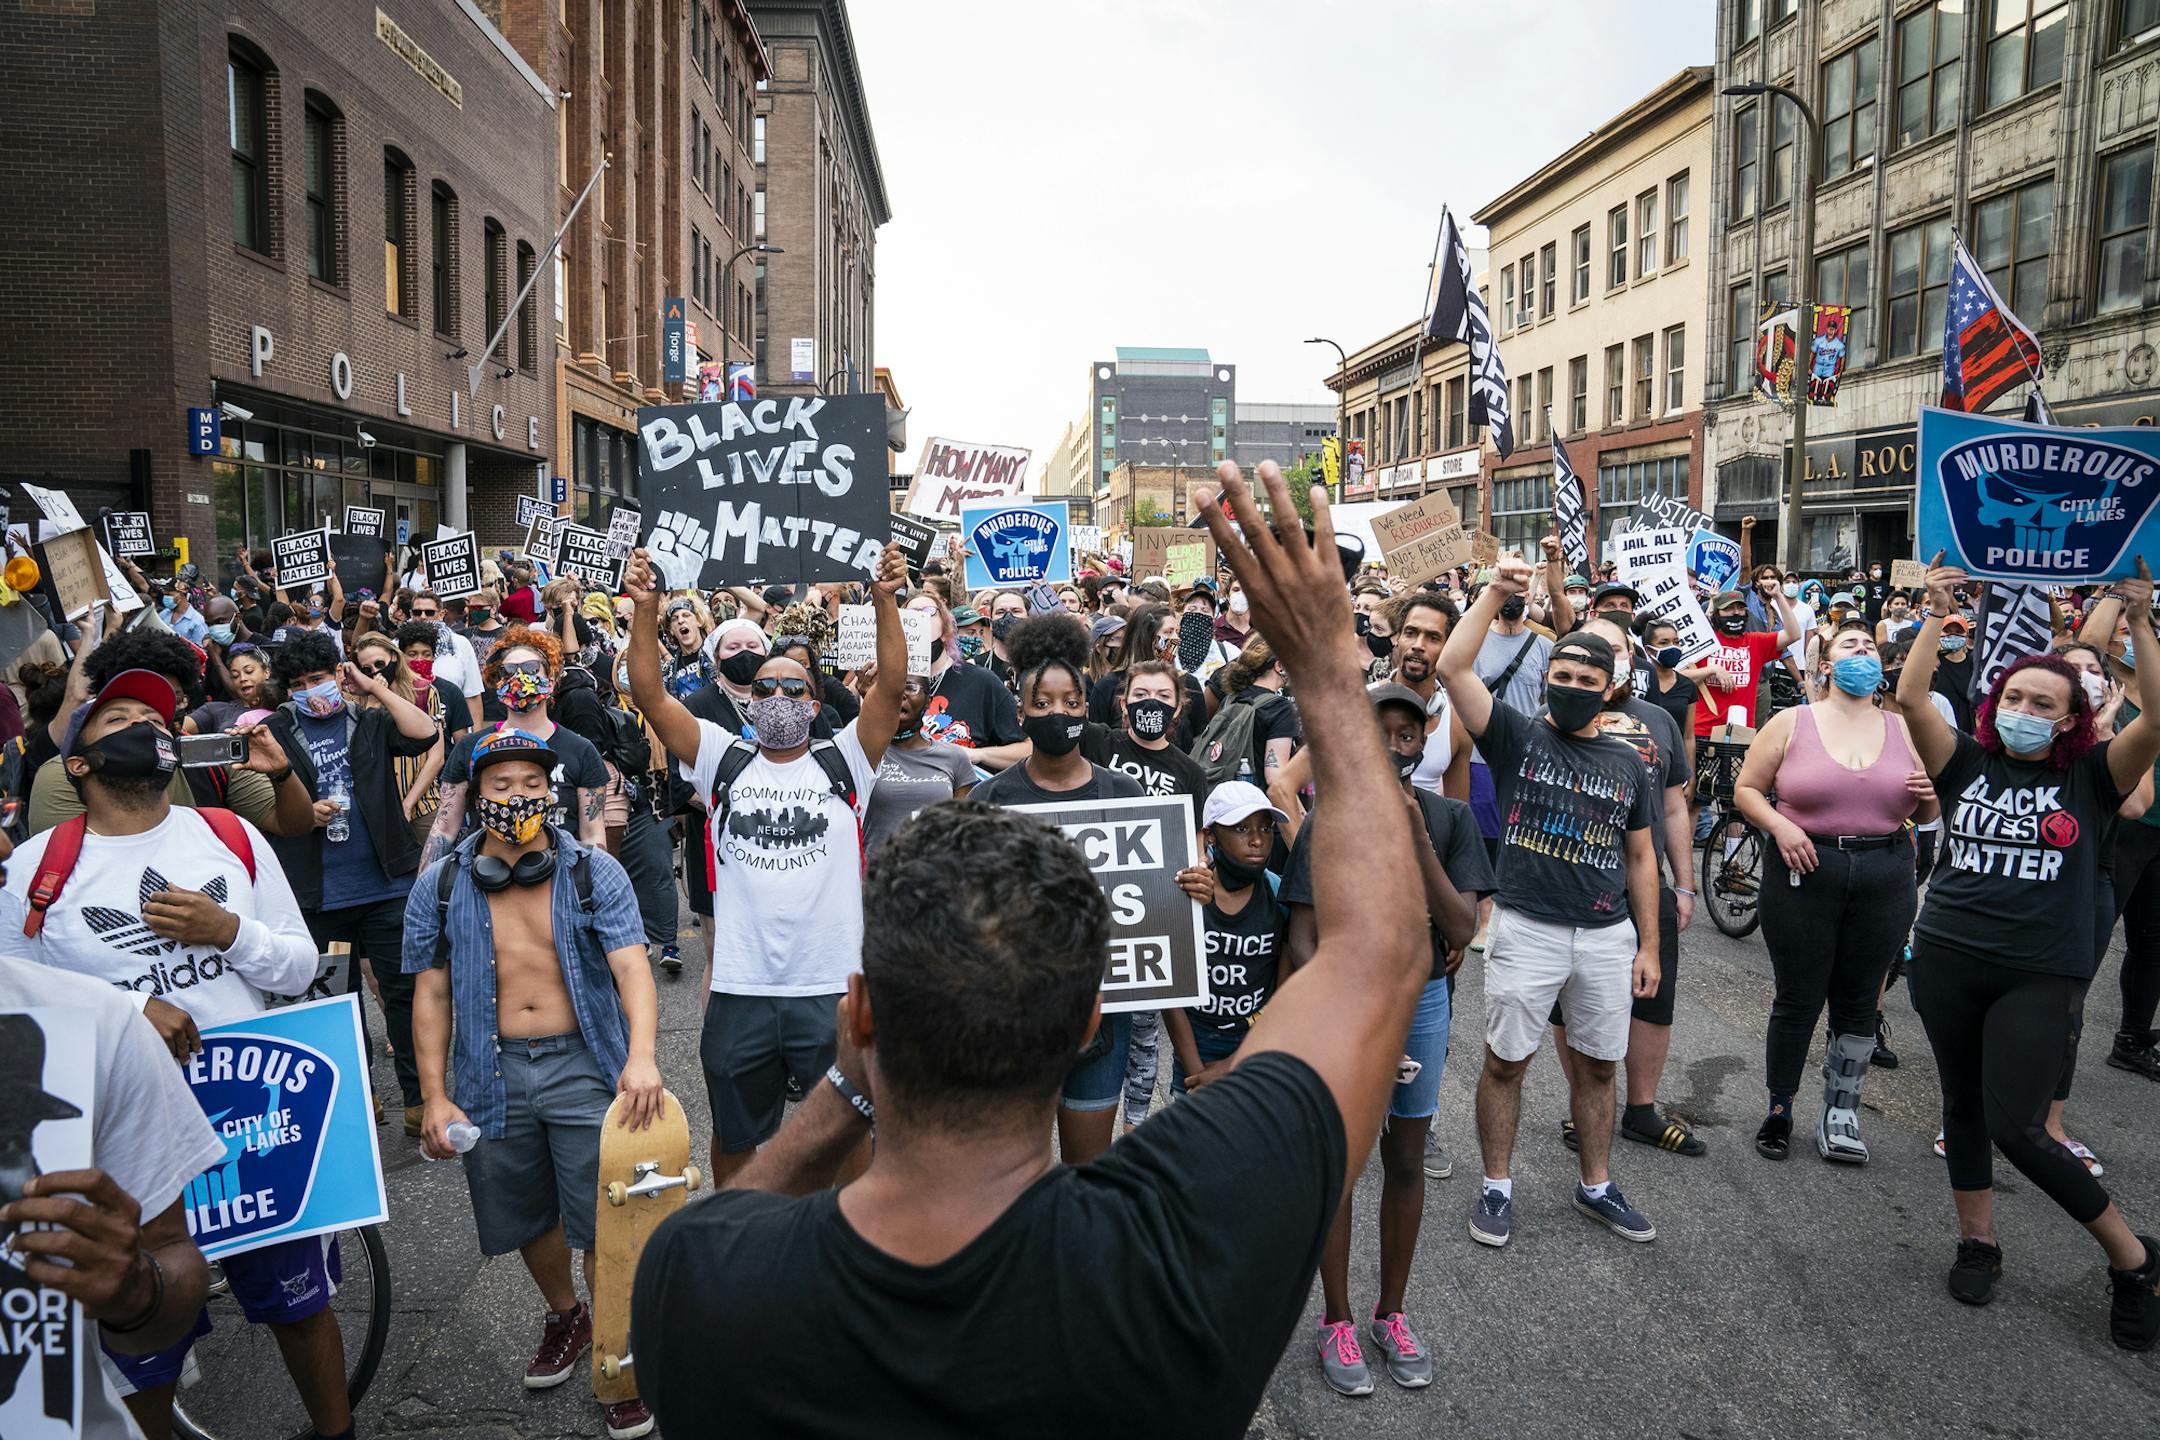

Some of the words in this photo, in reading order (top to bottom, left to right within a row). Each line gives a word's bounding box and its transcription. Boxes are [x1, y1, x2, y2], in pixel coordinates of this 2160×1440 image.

[669, 331, 681, 362] fjorge
[251, 325, 539, 450] POLICE
[200, 413, 213, 451] MPD
[641, 397, 826, 472] BLACK
[697, 440, 855, 497] LIVES
[925, 444, 979, 481] HOW
[972, 449, 1029, 486] MANY
[1443, 457, 1463, 475] STORE
[1803, 453, 1848, 481] L.A.
[1860, 443, 1915, 478] ROC
[1955, 444, 2154, 488] MURDEROUS
[1388, 467, 1414, 484] AMERICAN
[556, 480, 564, 501] MPD
[523, 498, 553, 513] BLACK
[1641, 491, 1713, 532] JUSTICE
[2060, 498, 2096, 513] CITY
[2100, 496, 2121, 511] OF
[2076, 507, 2126, 523] LAKES
[351, 511, 379, 525] BLACK
[978, 513, 1054, 539] MURDEROUS
[1378, 517, 1396, 532] We
[1398, 506, 1426, 523] Need
[1390, 510, 1452, 544] RESOURCES
[119, 529, 144, 540] IVES
[352, 523, 376, 537] LIVES
[890, 519, 908, 534] LACK
[909, 527, 929, 542] LIVES
[1070, 526, 1099, 537] LACK
[119, 539, 149, 551] ATTER
[279, 535, 322, 556] BLACK
[429, 540, 469, 562] BLACK
[710, 501, 885, 582] MATTER
[1622, 537, 1648, 552] JAIL
[1654, 533, 1678, 547] ALL
[283, 550, 319, 568] LIVES
[433, 558, 468, 578] LIVES
[569, 549, 611, 568] LIVES
[1392, 549, 1415, 567] Not
[1629, 552, 1673, 568] RACIST
[1987, 547, 2090, 569] POLICE
[280, 563, 325, 583] MATTER
[562, 562, 612, 584] MATTER
[999, 565, 1039, 579] POLICE
[432, 574, 474, 594] MATTER
[1655, 576, 1680, 597] ALL
[840, 641, 877, 651] AGAINST
[1136, 708, 1163, 718] BLACK
[1136, 716, 1163, 726] LIVES
[1136, 723, 1163, 734] MATTER
[489, 738, 538, 750] ATTITUDE
[1108, 753, 1176, 794] LOVE
[731, 785, 829, 808] COMMUNITY
[1960, 774, 2063, 813] BLACK
[757, 825, 796, 837] NEEDS
[1951, 802, 2038, 845] LIVES
[726, 841, 829, 871] COMMUNITY
[1950, 837, 2063, 881] MATTER
[222, 1115, 263, 1139] CITY
[270, 1108, 292, 1128] OF
[246, 1124, 302, 1153] LAKES
